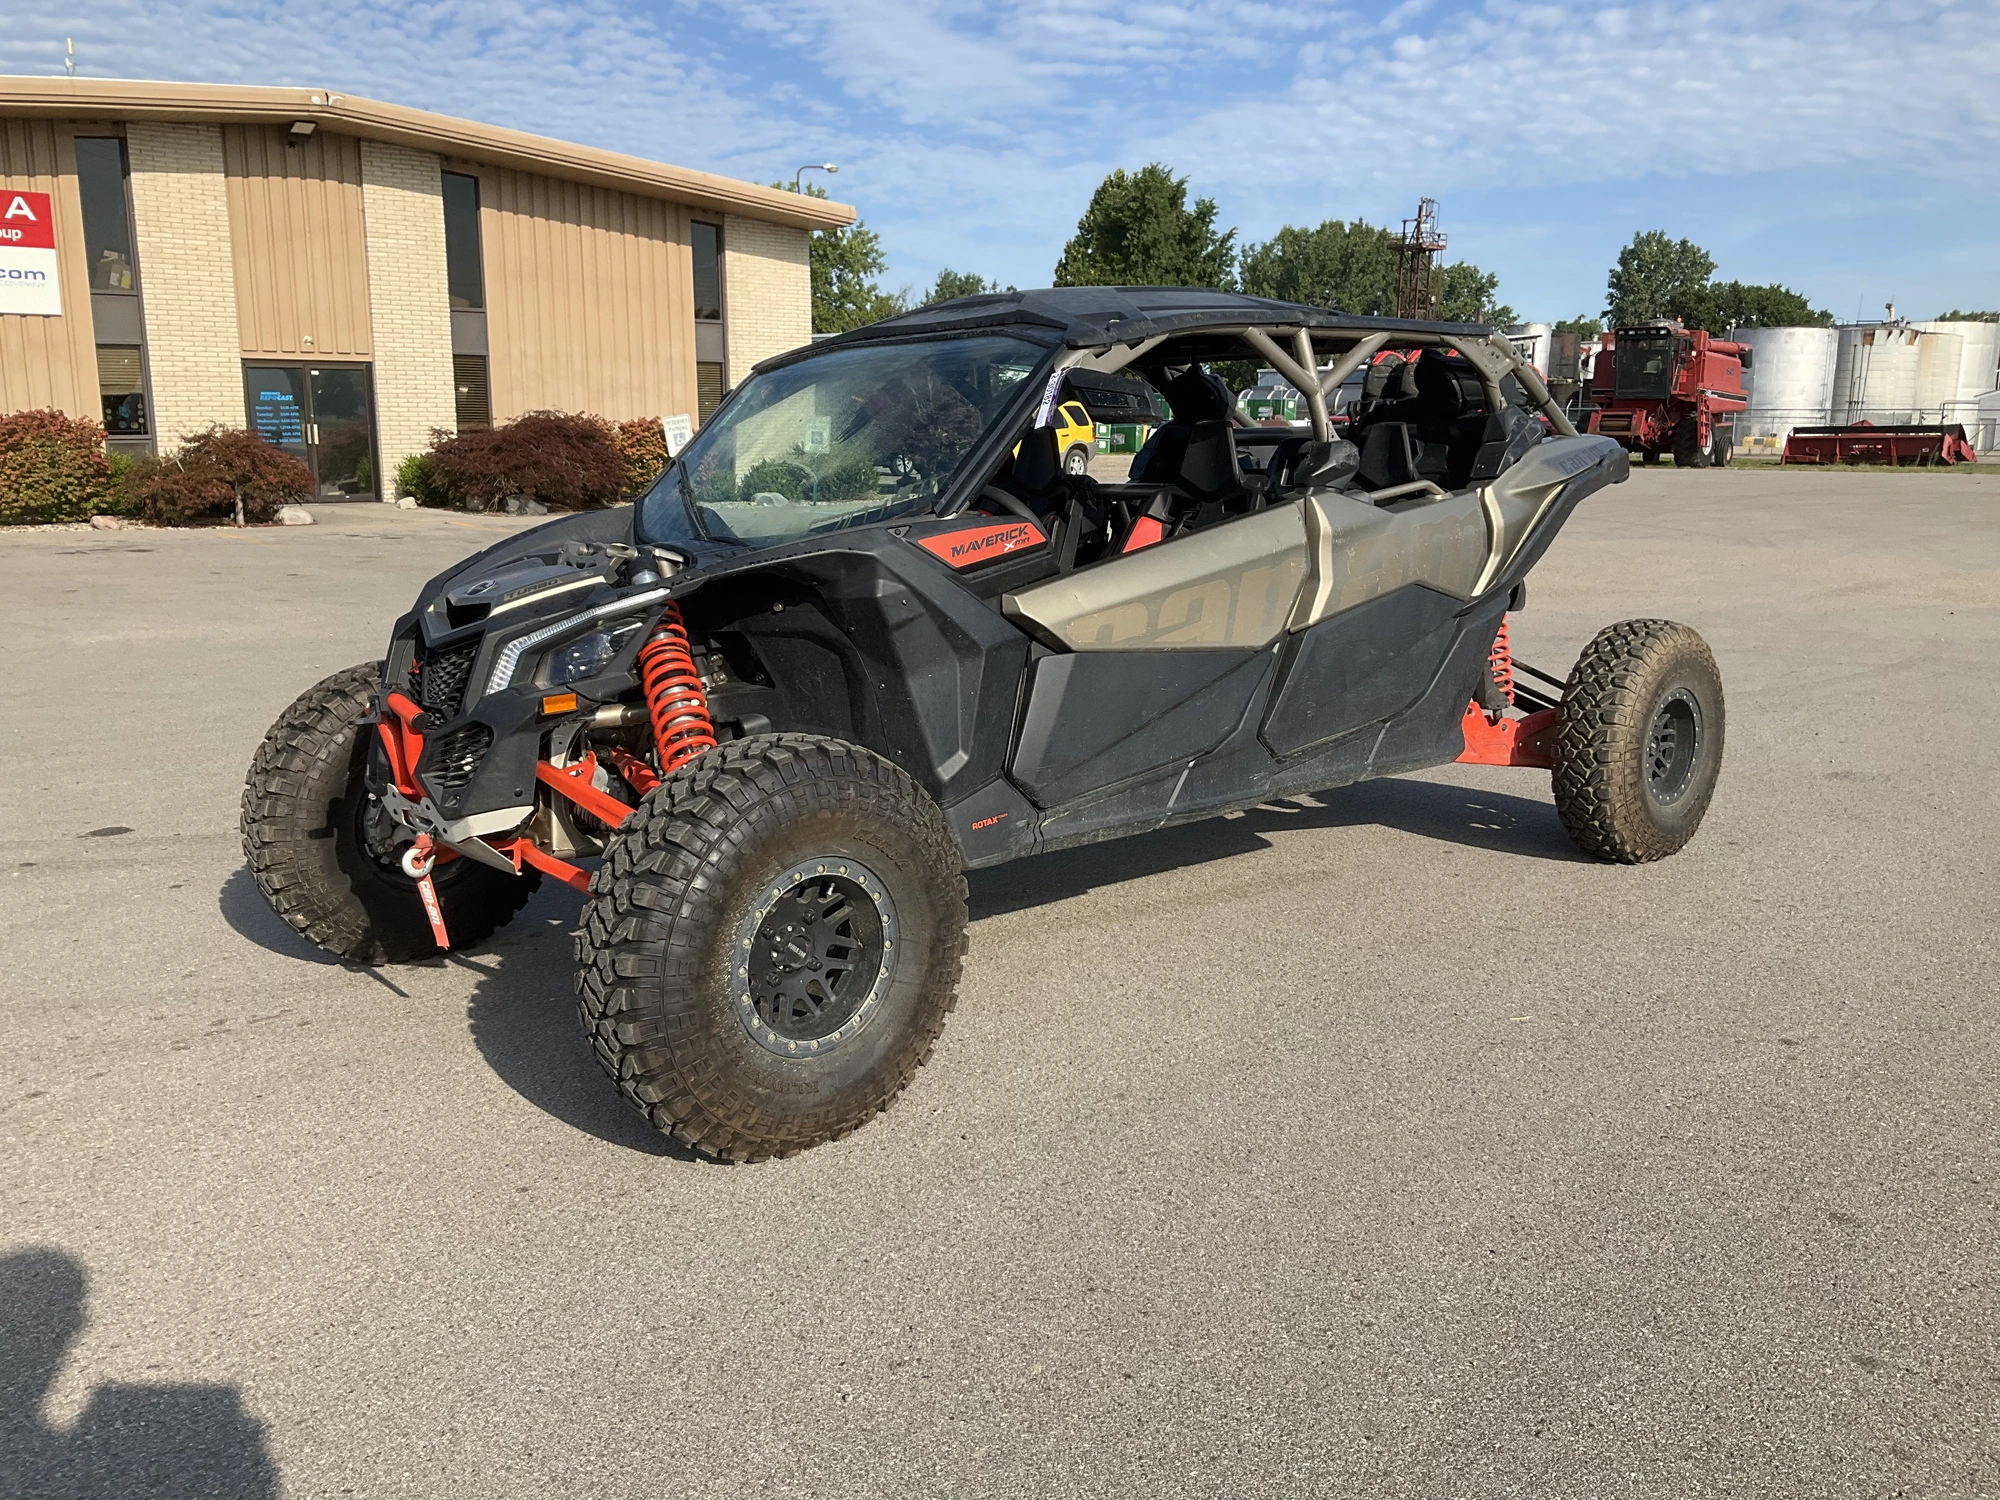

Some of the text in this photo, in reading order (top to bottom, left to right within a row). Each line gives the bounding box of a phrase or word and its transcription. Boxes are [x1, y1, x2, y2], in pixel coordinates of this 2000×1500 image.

[0, 228, 22, 241] up
[951, 525, 1028, 557] MAVERICK
[506, 579, 558, 598] TURBO
[972, 816, 998, 830] ROTAX
[420, 881, 441, 925] can-am
